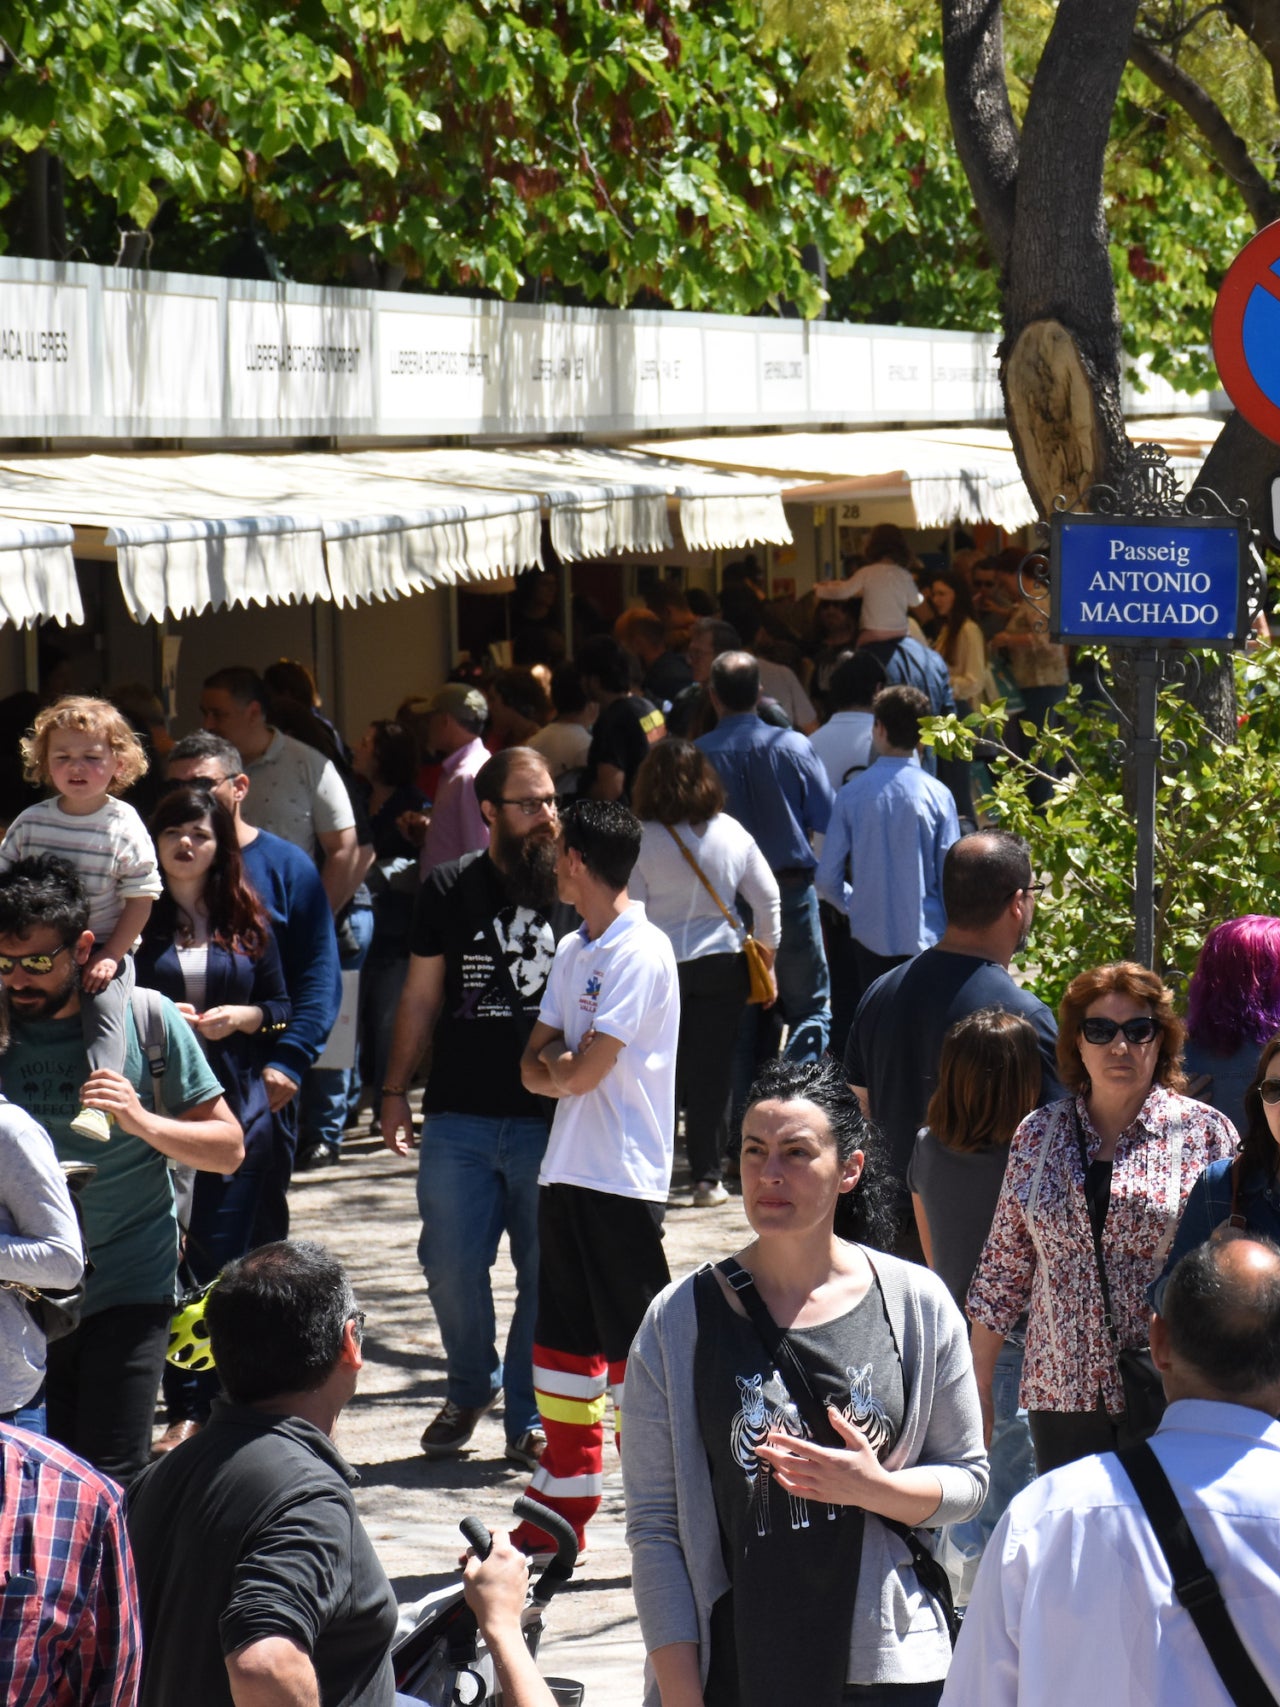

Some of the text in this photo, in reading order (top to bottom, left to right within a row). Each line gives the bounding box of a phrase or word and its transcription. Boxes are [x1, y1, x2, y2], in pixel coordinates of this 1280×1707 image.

[25, 331, 68, 362] LLIBRES
[842, 504, 860, 519] 28
[1109, 540, 1190, 566] Passeig
[1088, 571, 1211, 593] ANTONIO
[1080, 602, 1219, 624] MACHADO
[20, 1061, 78, 1079] HOUSE
[22, 1103, 79, 1116] ERFECT
